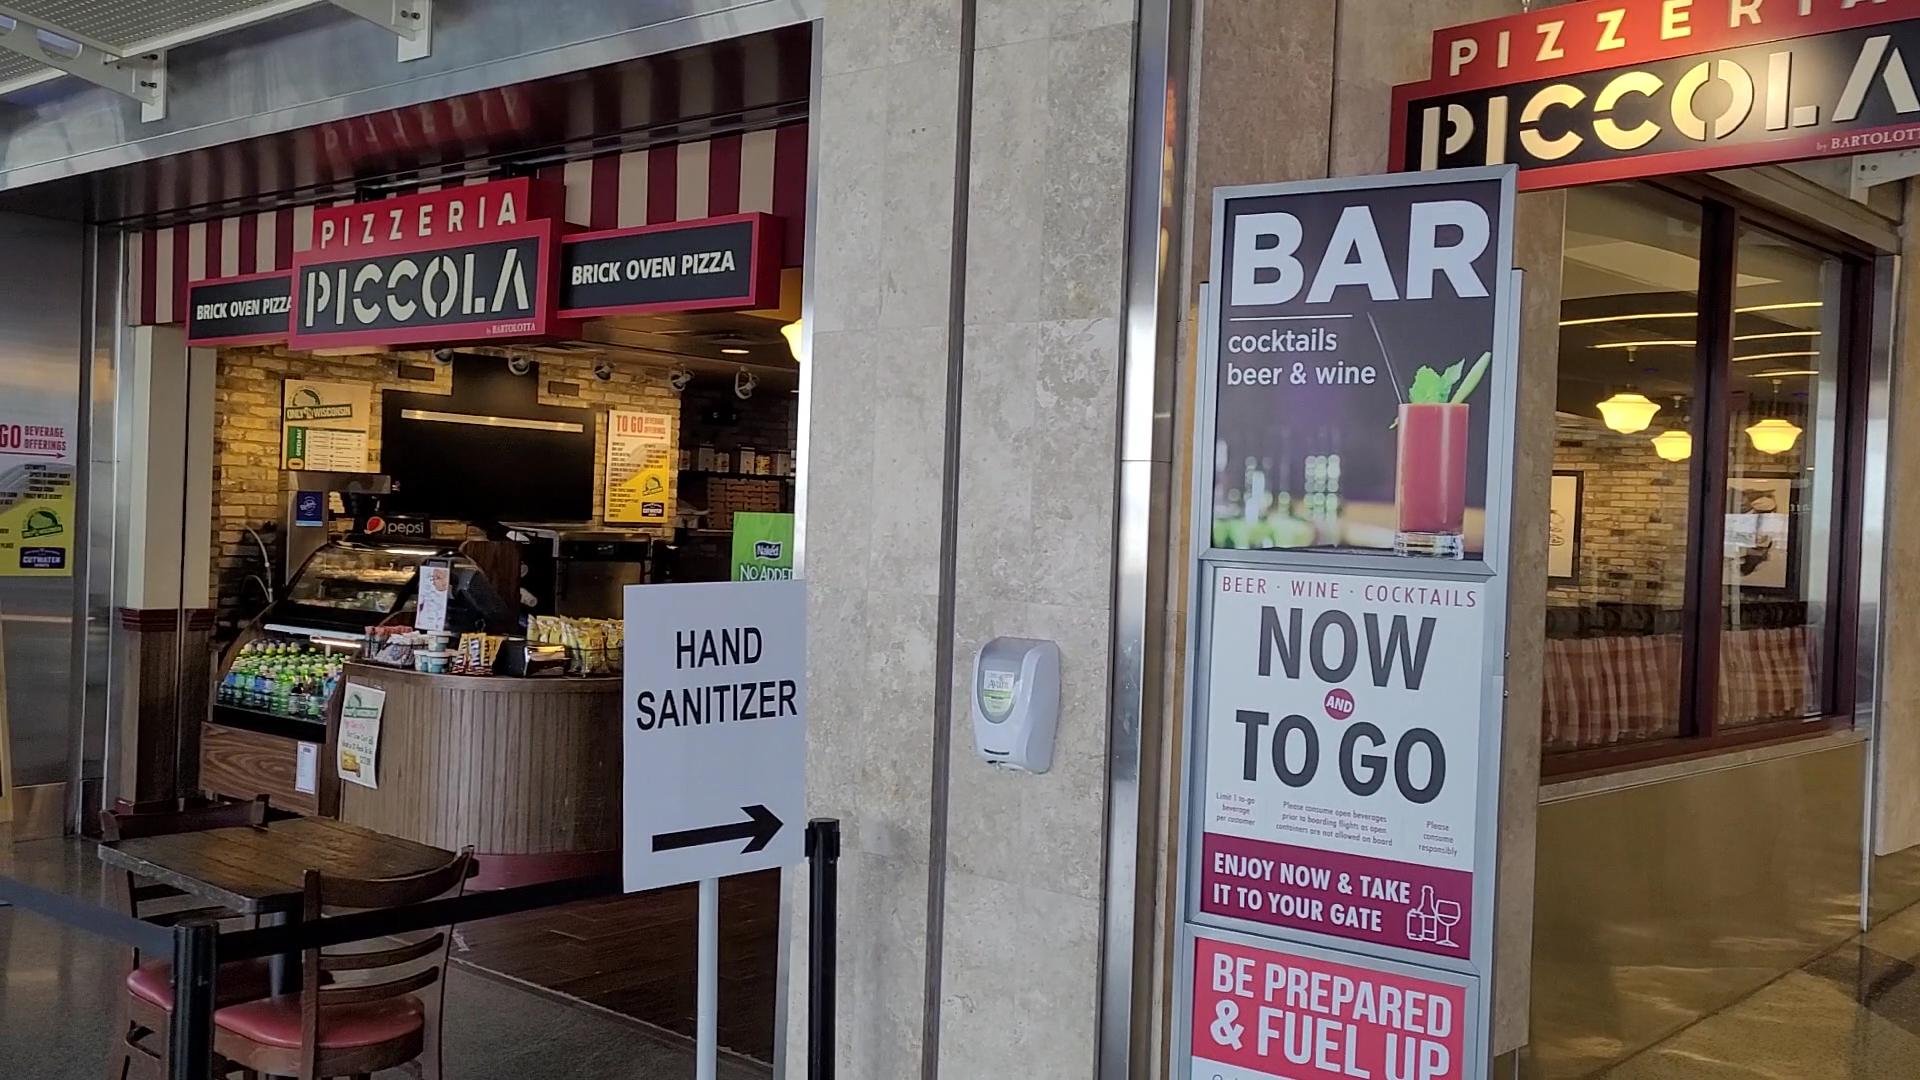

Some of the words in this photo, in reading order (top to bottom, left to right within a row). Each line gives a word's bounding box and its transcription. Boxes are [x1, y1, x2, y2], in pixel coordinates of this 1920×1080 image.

[1449, 0, 1887, 76] PIZZER
[1421, 34, 1920, 171] PICCOLA
[320, 192, 517, 249] PIZZERIA
[1231, 200, 1491, 306] BAR
[571, 258, 621, 286] BRICK
[626, 255, 676, 282] OVEN
[681, 249, 735, 276] PIZZA
[305, 248, 529, 328] PICCOLA
[197, 303, 228, 320] BRICK
[230, 299, 260, 317] OVEN
[1227, 328, 1338, 353] cocktails
[1227, 362, 1283, 386] beer
[1289, 363, 1307, 385] &
[1315, 361, 1377, 385] wine
[287, 408, 305, 419] ONLY
[314, 406, 351, 417] WISCONSIN
[616, 415, 628, 432] TO
[631, 415, 643, 433] GO
[0, 424, 21, 448] GO
[25, 426, 64, 437] BEVERAGE
[25, 439, 66, 451] OFFERINGS
[388, 522, 424, 535] pepsi
[740, 564, 759, 581] NO
[1222, 576, 1267, 594] BEER
[1291, 581, 1340, 598] WINE
[1364, 585, 1477, 607] COCKTAILS
[676, 627, 762, 669] HAND
[1258, 605, 1437, 690] NOW
[636, 679, 798, 731] SANITIZER
[1325, 695, 1353, 714] AND
[1235, 709, 1319, 788] TO
[1339, 722, 1446, 804] GO
[1281, 813, 1298, 821] prior
[1299, 814, 1306, 822] to
[1307, 816, 1337, 828] boarding
[1338, 818, 1359, 830] flights
[1369, 825, 1387, 834] open
[1283, 800, 1304, 811] Please
[1305, 806, 1333, 815] consume
[1335, 809, 1351, 818] open
[1353, 810, 1388, 823] beverages
[1310, 828, 1320, 836] are
[1322, 830, 1333, 838] not
[1334, 831, 1360, 841] allowed
[1362, 835, 1371, 843] on
[1372, 836, 1393, 847] board
[1423, 833, 1454, 843] consume
[1426, 820, 1449, 831] Please
[1418, 844, 1457, 857] responsibly
[1214, 852, 1275, 881] ENJOY
[1280, 864, 1331, 890] NOW
[1337, 872, 1352, 895] &
[1360, 875, 1411, 904] TAKE
[1213, 883, 1232, 905] IT
[1237, 887, 1262, 911] TO
[1268, 892, 1323, 922] YOUR
[1330, 904, 1382, 932] GATE
[1212, 953, 1255, 998] BE
[1264, 963, 1451, 1038] PREPARED
[1210, 999, 1245, 1051] &
[1257, 1005, 1370, 1079] FUEL
[1384, 1032, 1451, 1080] UP
